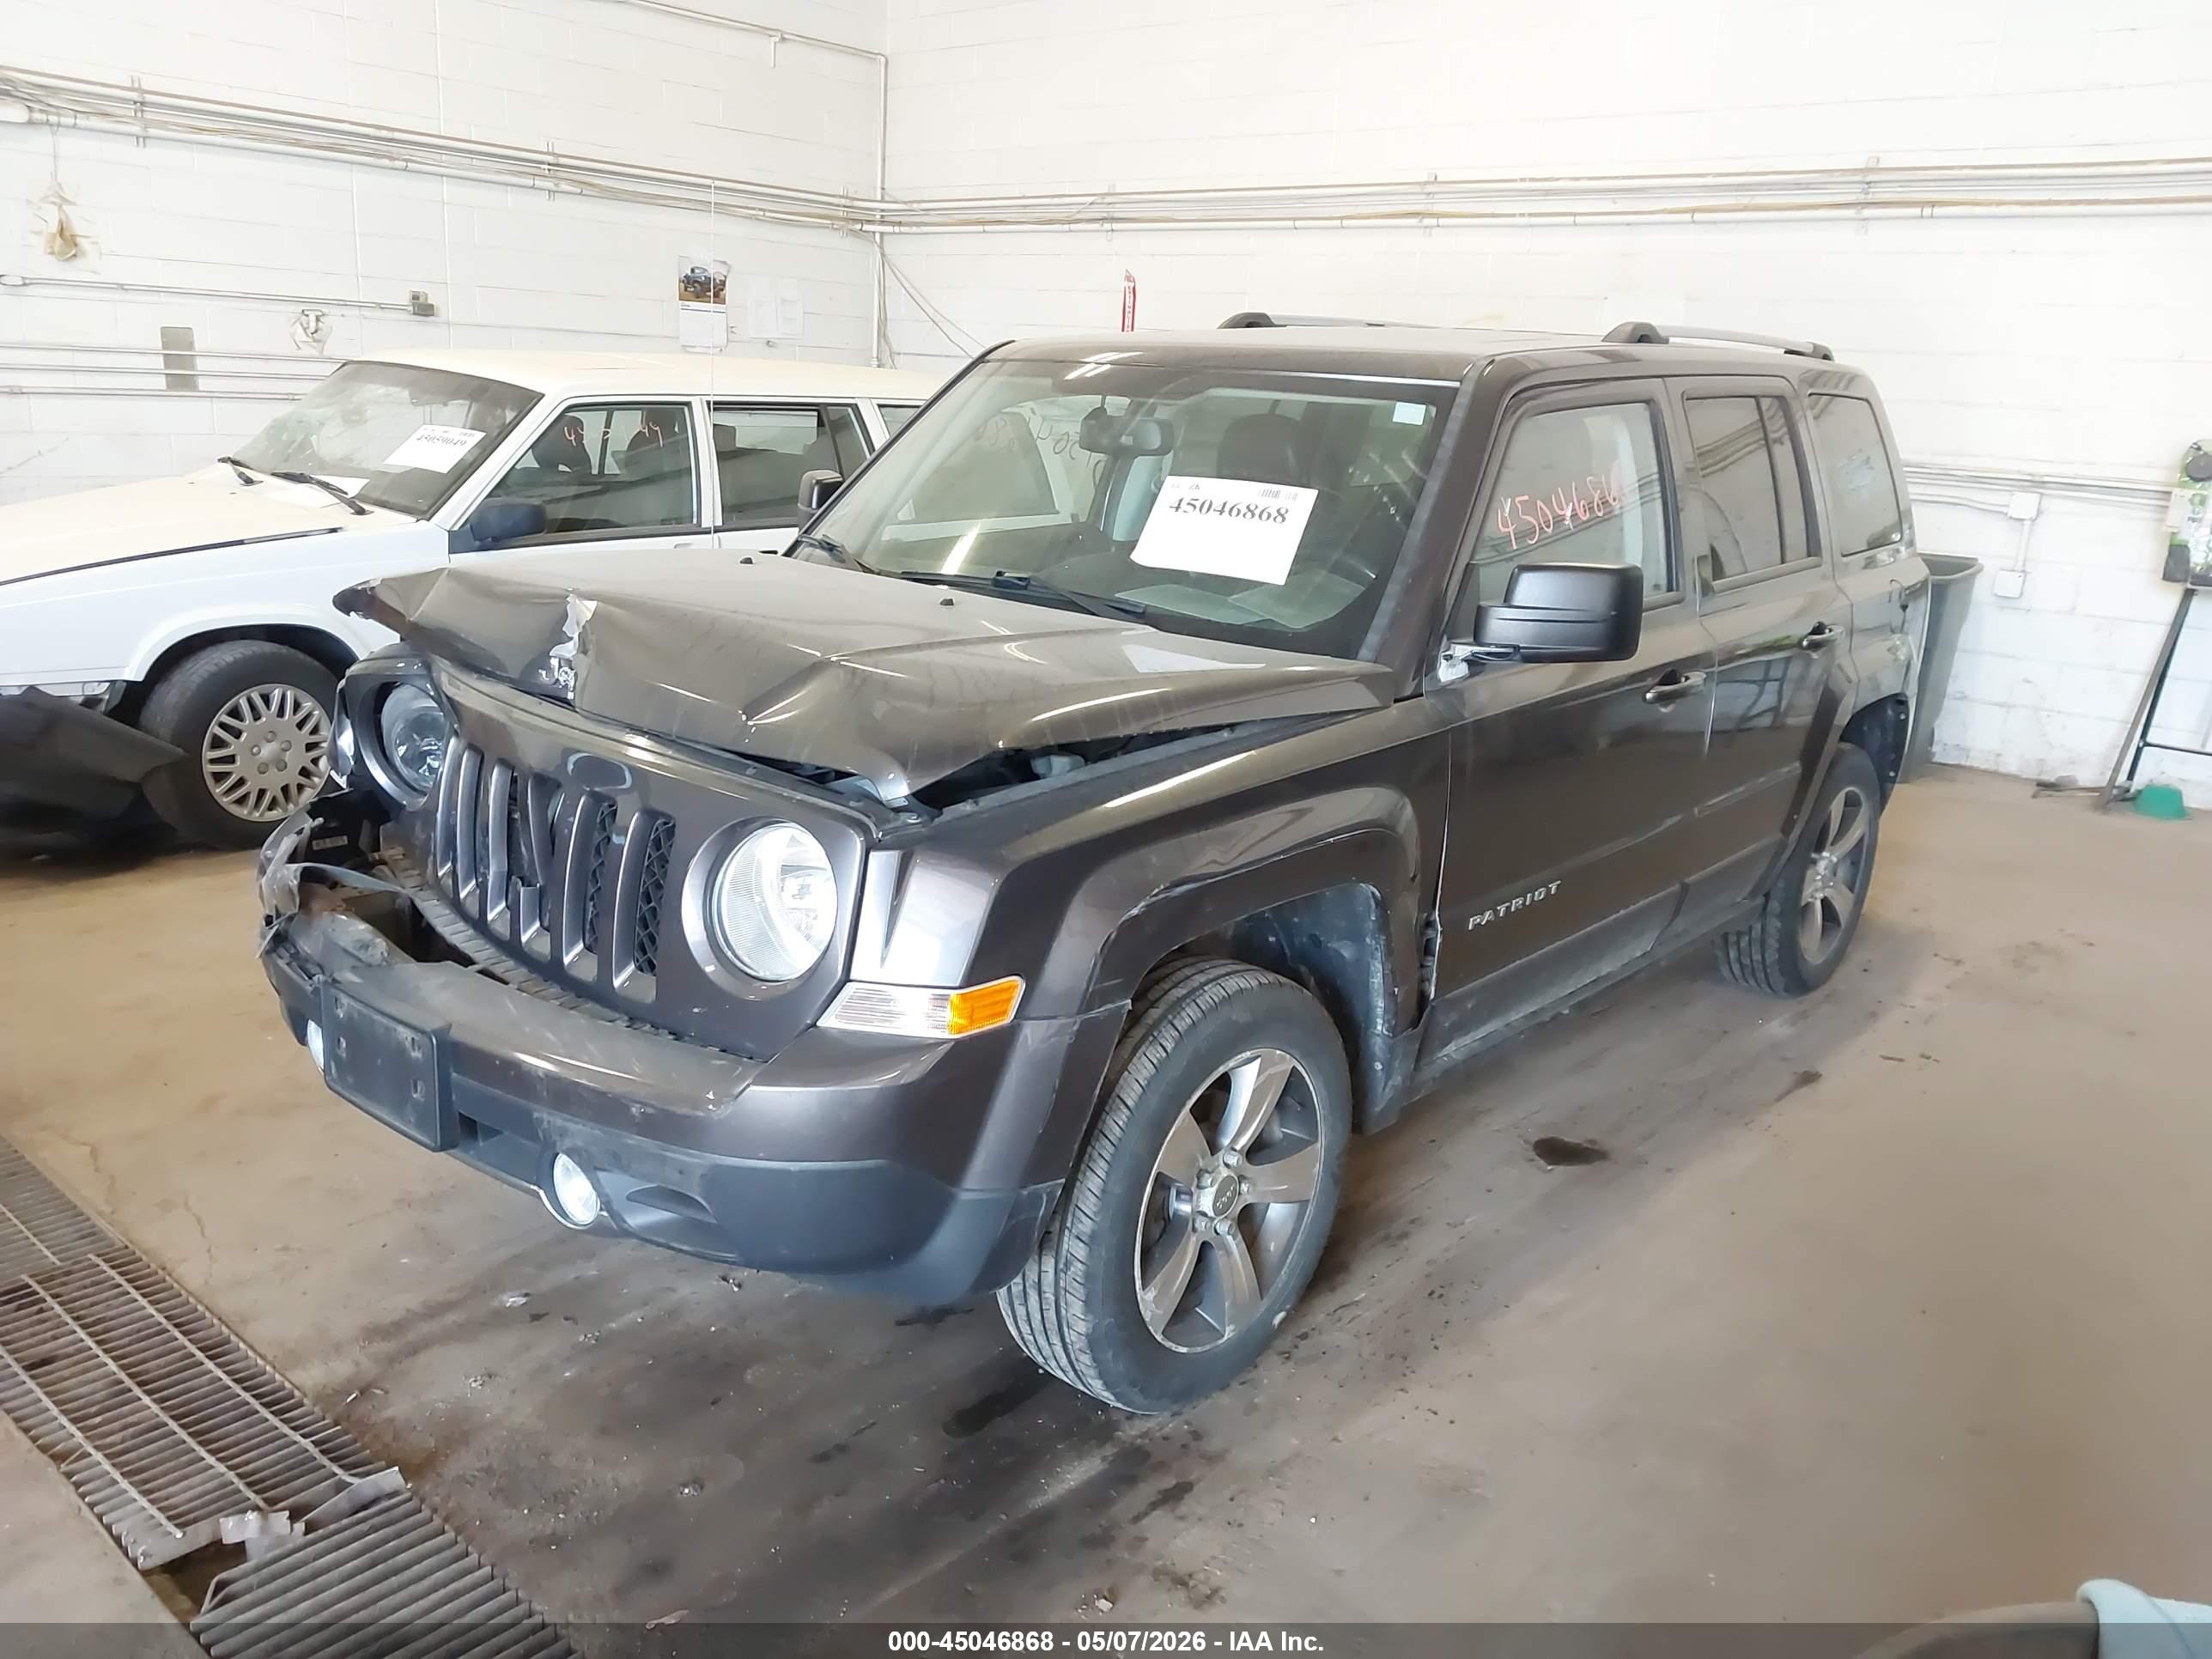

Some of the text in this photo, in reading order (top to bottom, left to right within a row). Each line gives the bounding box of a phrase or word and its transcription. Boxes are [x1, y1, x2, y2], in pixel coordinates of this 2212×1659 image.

[1169, 496, 1289, 524] 45046868
[1498, 473, 1620, 550] 4504686
[1468, 879, 1562, 931] PATRIOT
